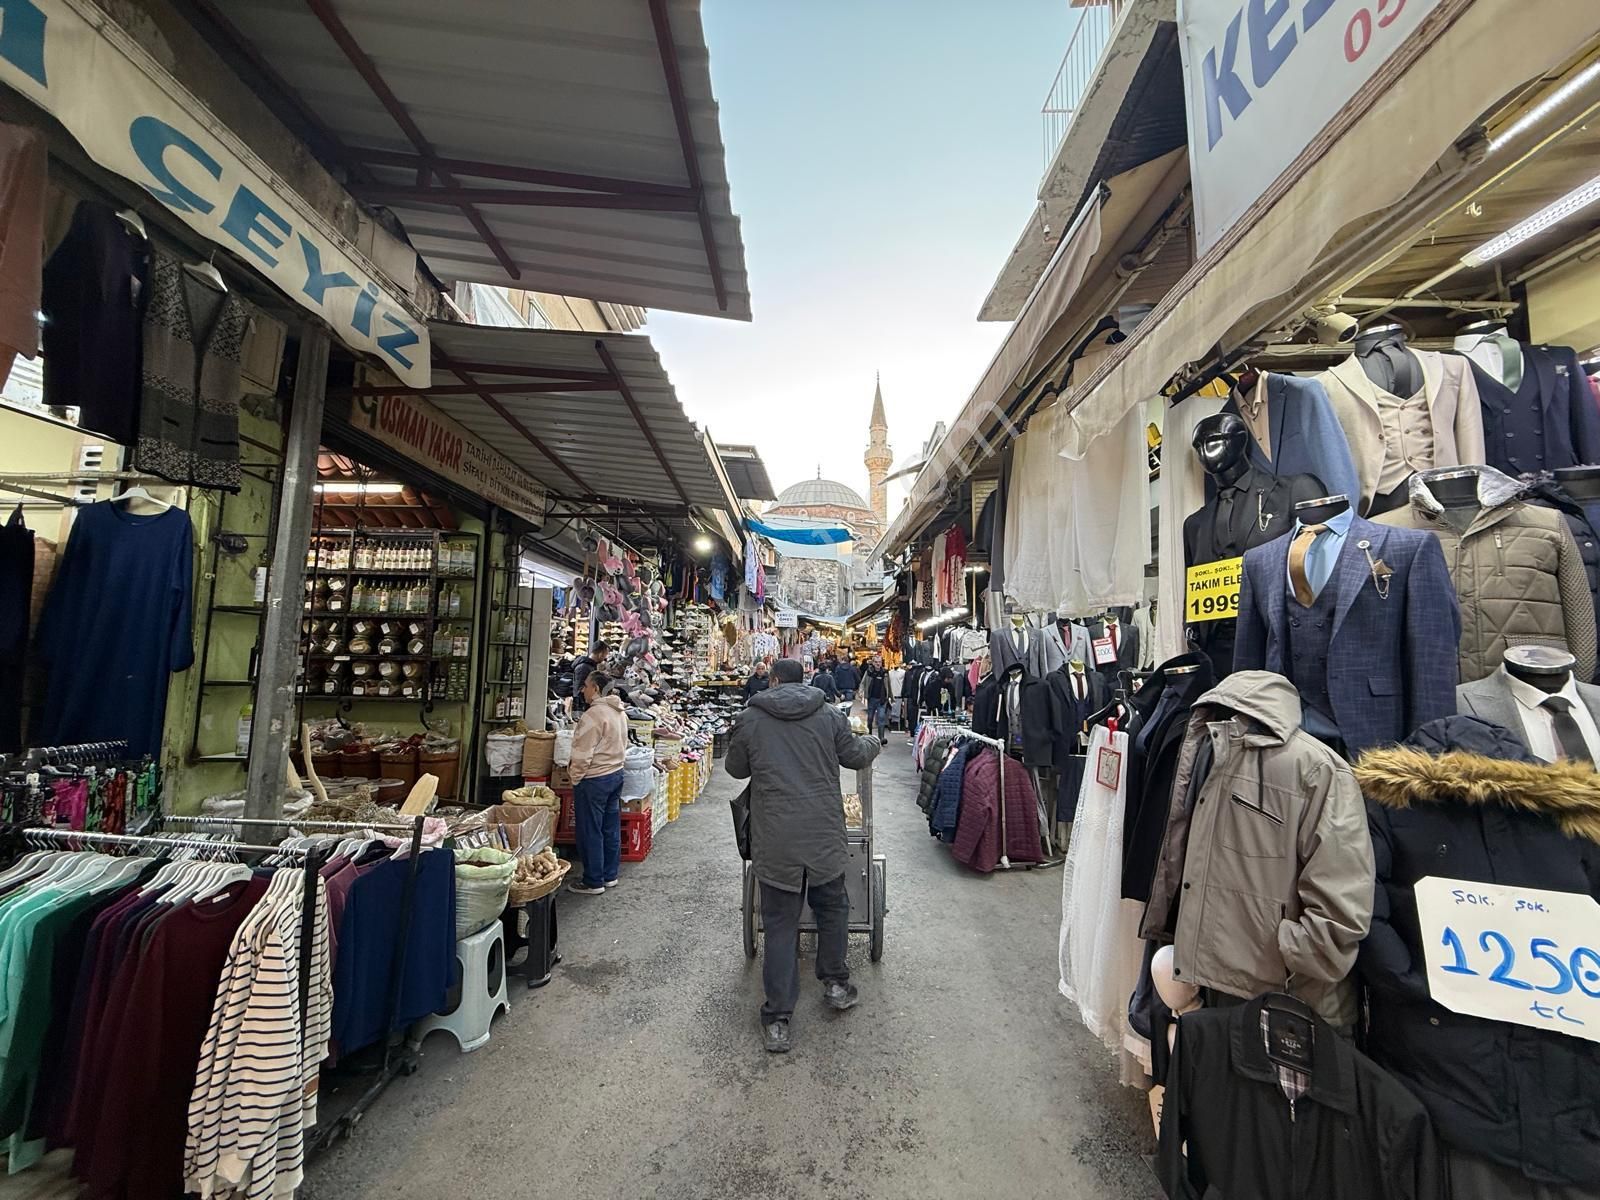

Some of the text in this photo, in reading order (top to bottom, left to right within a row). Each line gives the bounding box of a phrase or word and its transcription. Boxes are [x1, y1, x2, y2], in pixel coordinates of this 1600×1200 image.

[380, 394, 463, 474] OSMAN YAŞAR
[1189, 577, 1220, 592] TAKIM
[1190, 592, 1240, 615] 1999
[1440, 926, 1600, 998] 1250
